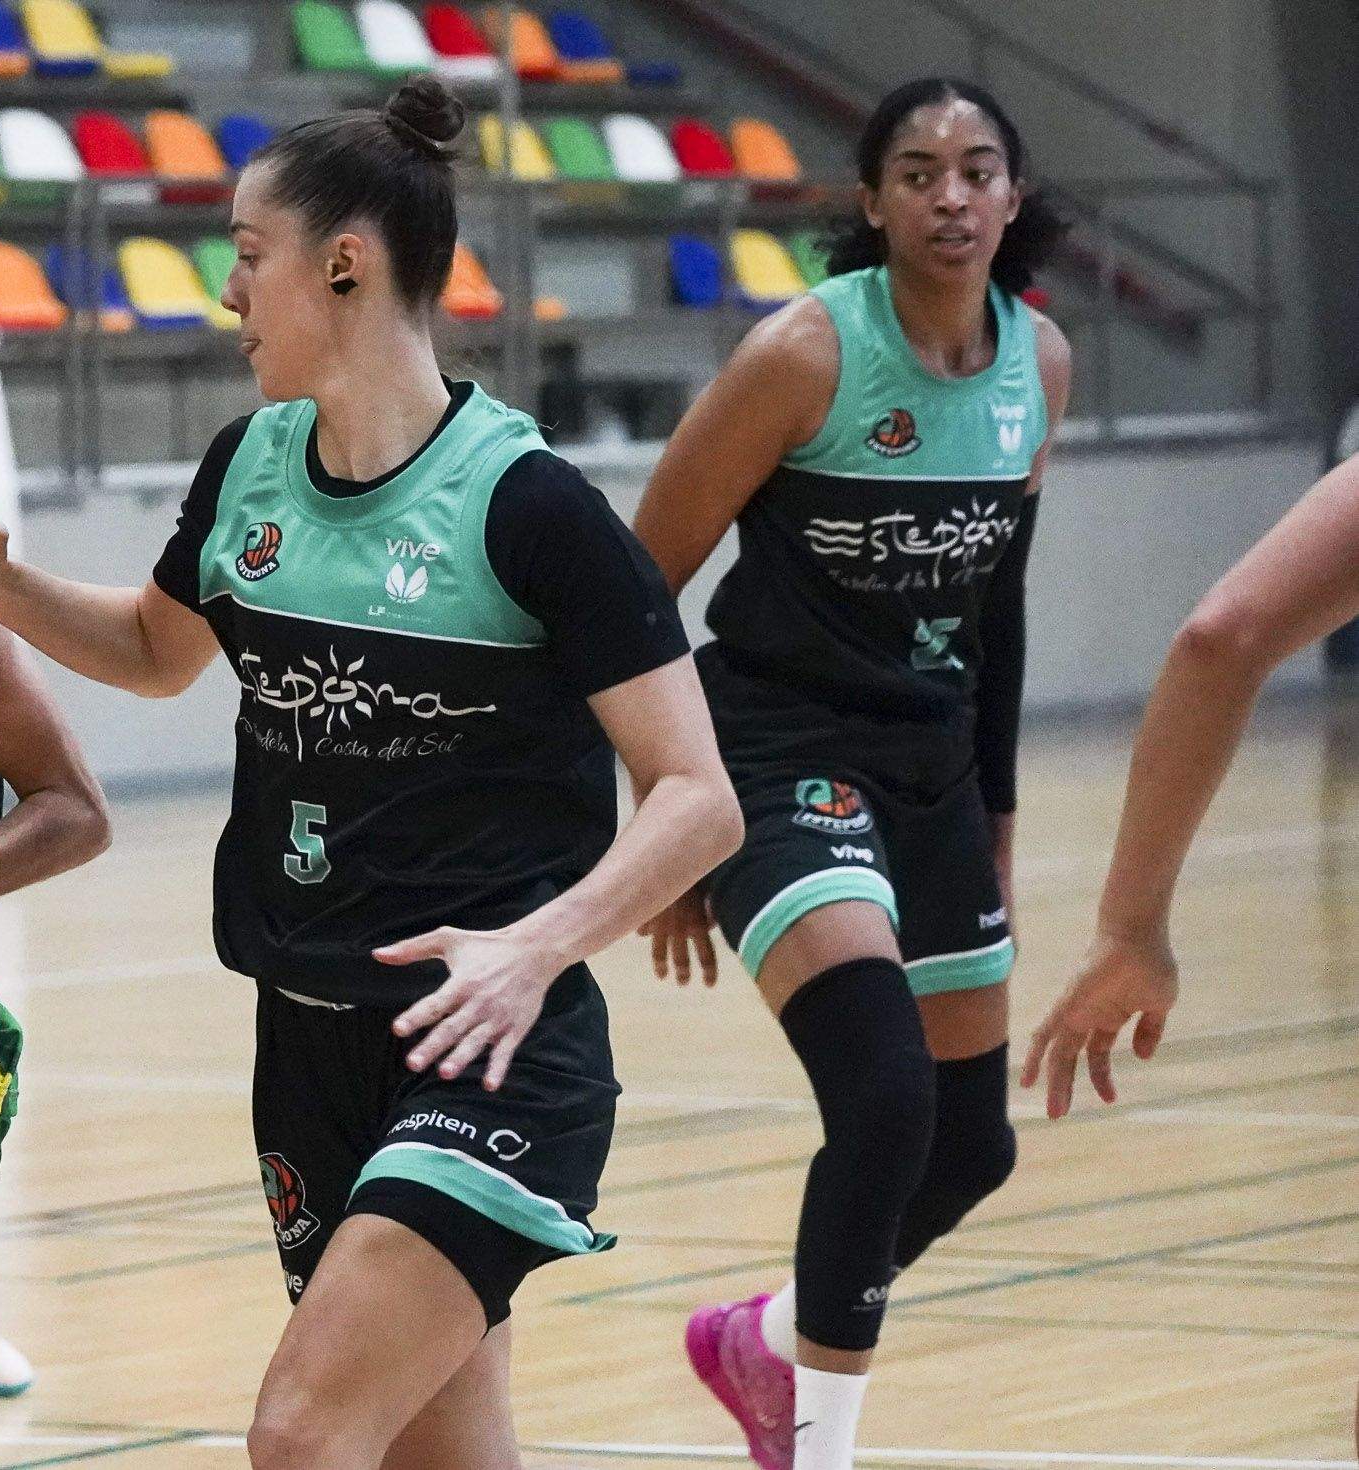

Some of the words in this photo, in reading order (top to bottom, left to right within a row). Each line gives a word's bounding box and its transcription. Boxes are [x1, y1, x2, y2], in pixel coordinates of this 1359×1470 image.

[385, 535, 441, 562] vive
[314, 737, 373, 758] Costa
[377, 736, 417, 761] del
[417, 731, 464, 756] Sol
[283, 799, 332, 885] 5
